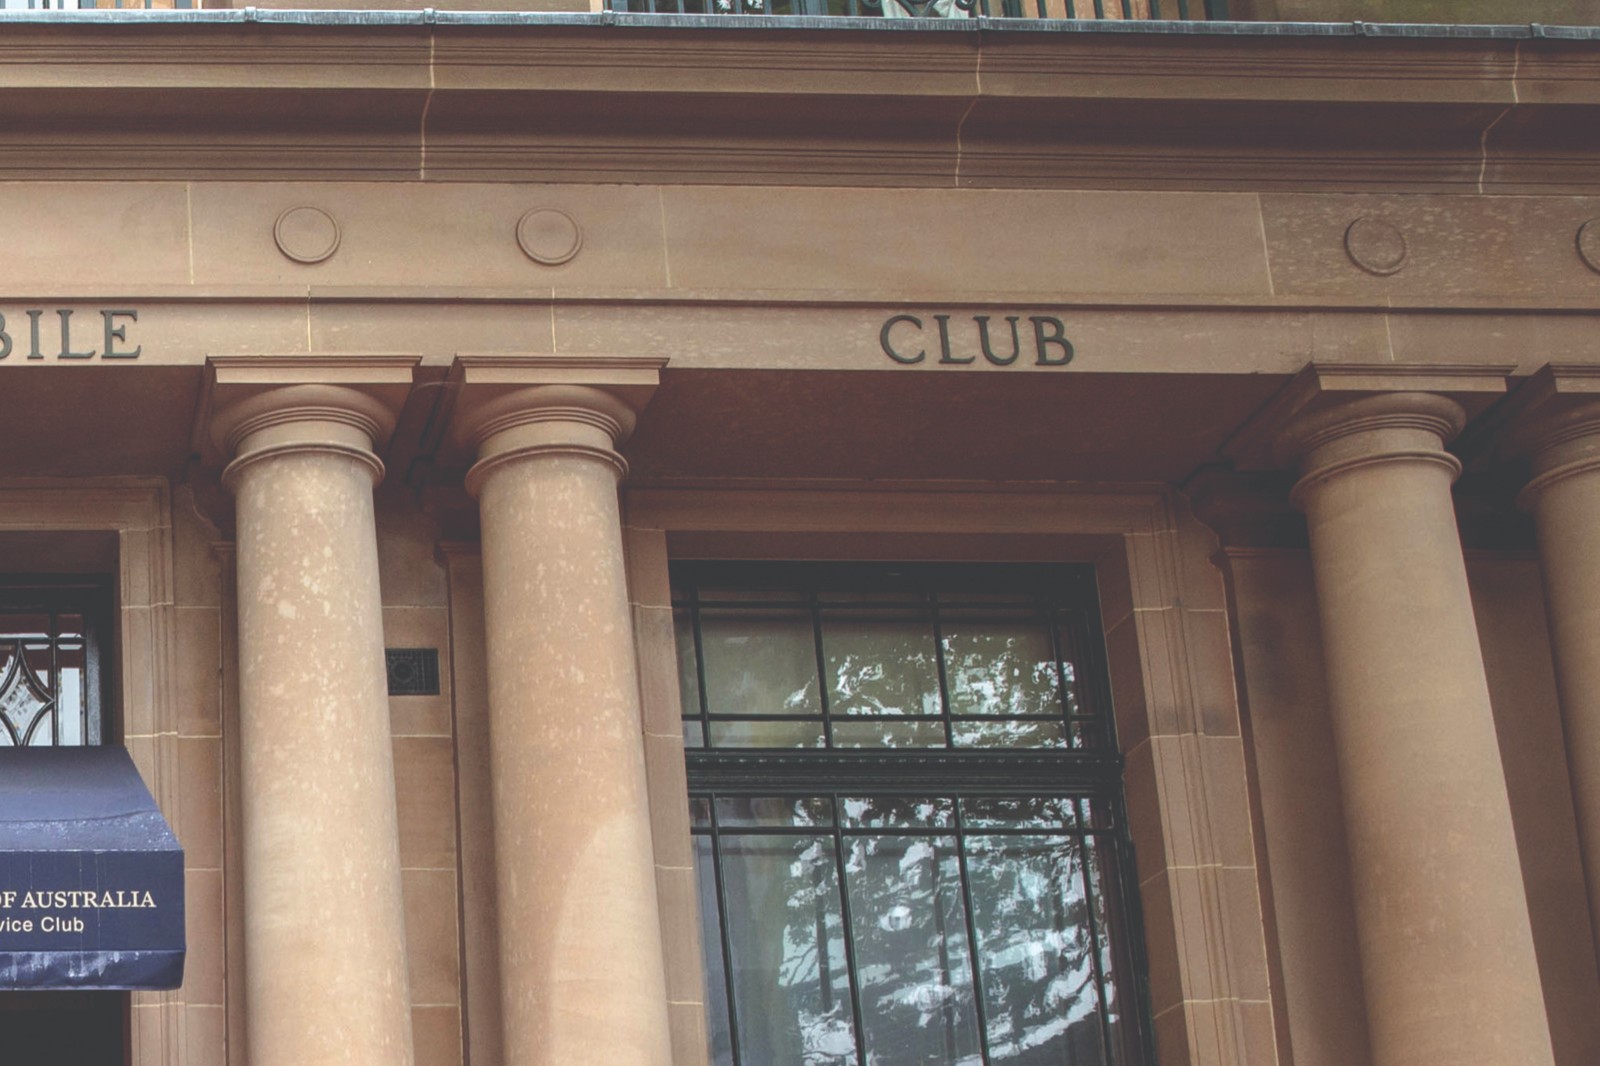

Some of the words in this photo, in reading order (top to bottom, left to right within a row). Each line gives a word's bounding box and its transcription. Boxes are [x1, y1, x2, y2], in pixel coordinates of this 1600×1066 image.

[879, 315, 1075, 366] CLUB
[21, 891, 157, 908] AUSTRALIA
[41, 916, 84, 933] Club
